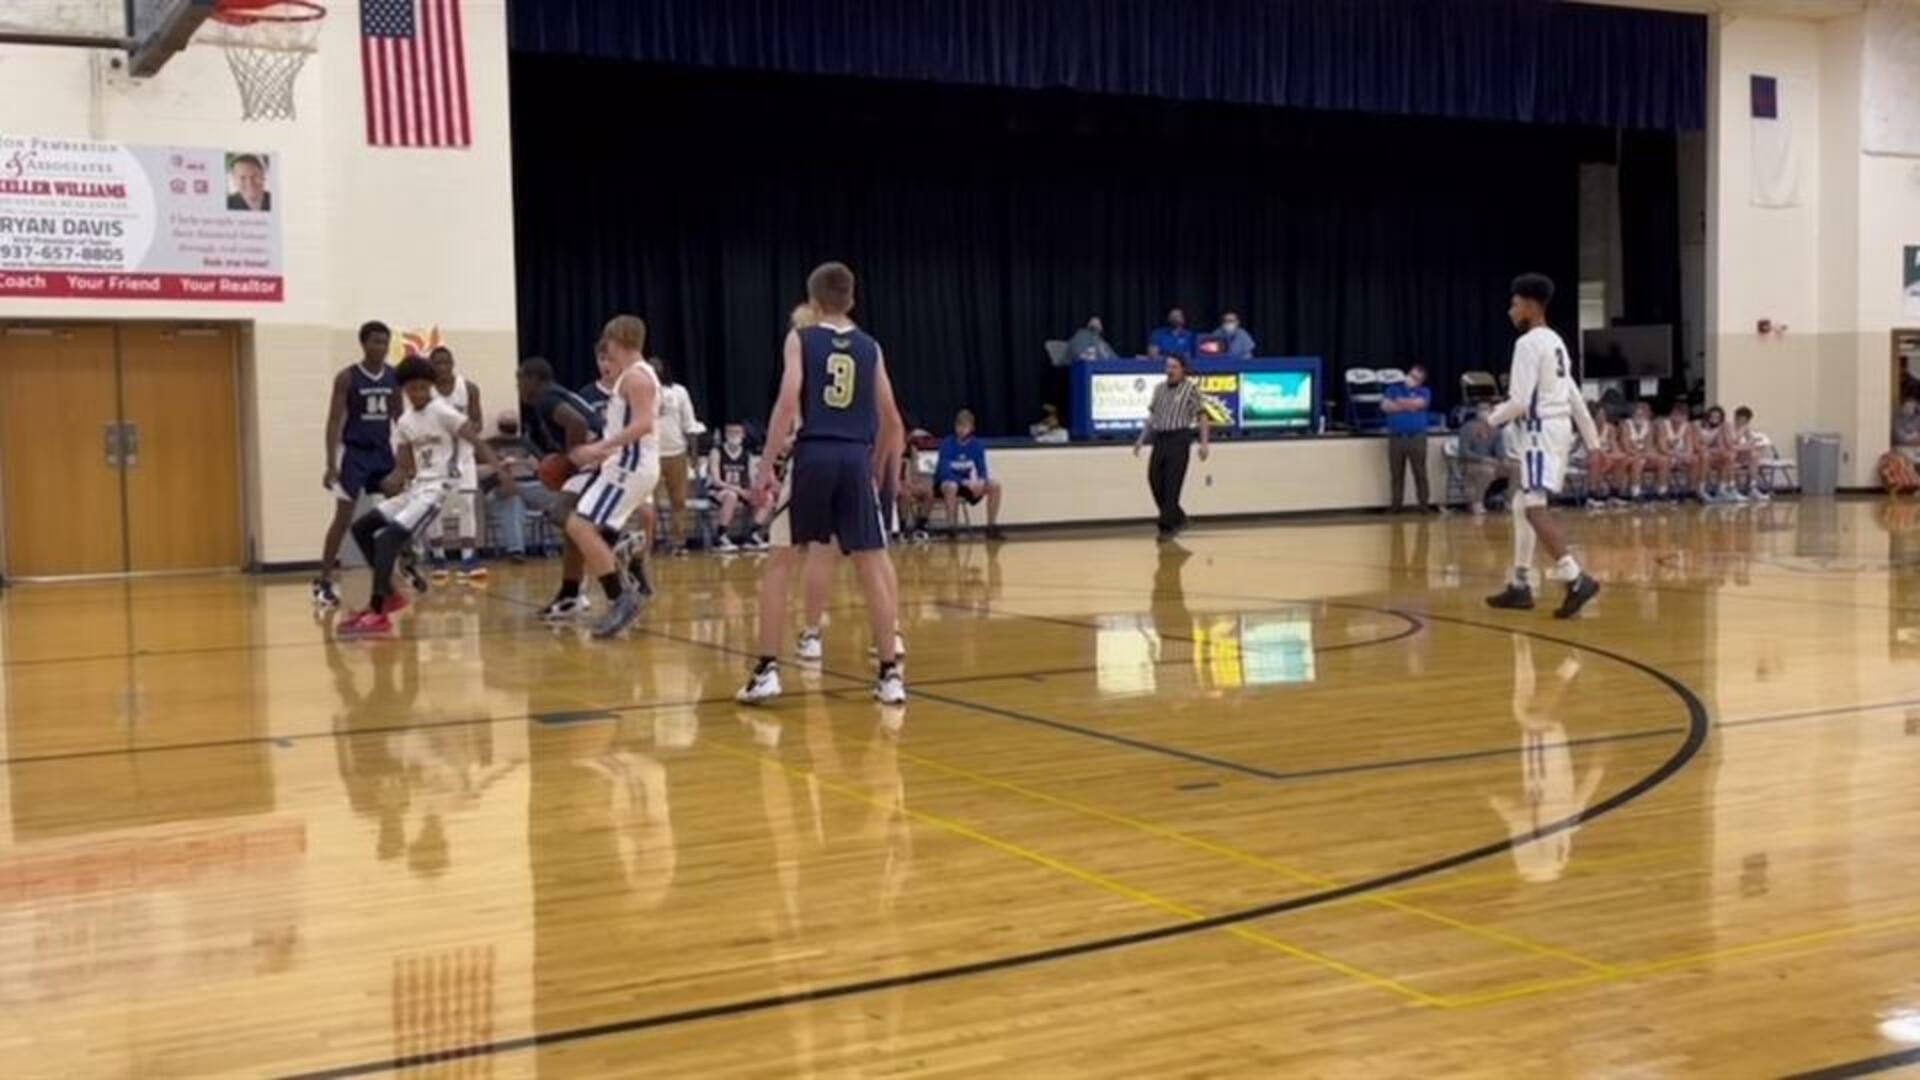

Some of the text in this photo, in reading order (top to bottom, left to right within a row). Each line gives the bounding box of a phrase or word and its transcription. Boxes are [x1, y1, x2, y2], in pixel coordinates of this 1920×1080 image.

[53, 181, 126, 199] WILLIAMS
[0, 216, 124, 237] RYAN DAVIS
[66, 274, 104, 289] Your
[109, 275, 161, 292] Friend
[179, 277, 216, 292] Your
[219, 278, 276, 294] Realtor
[1555, 347, 1566, 378] 3
[824, 352, 856, 409] 3
